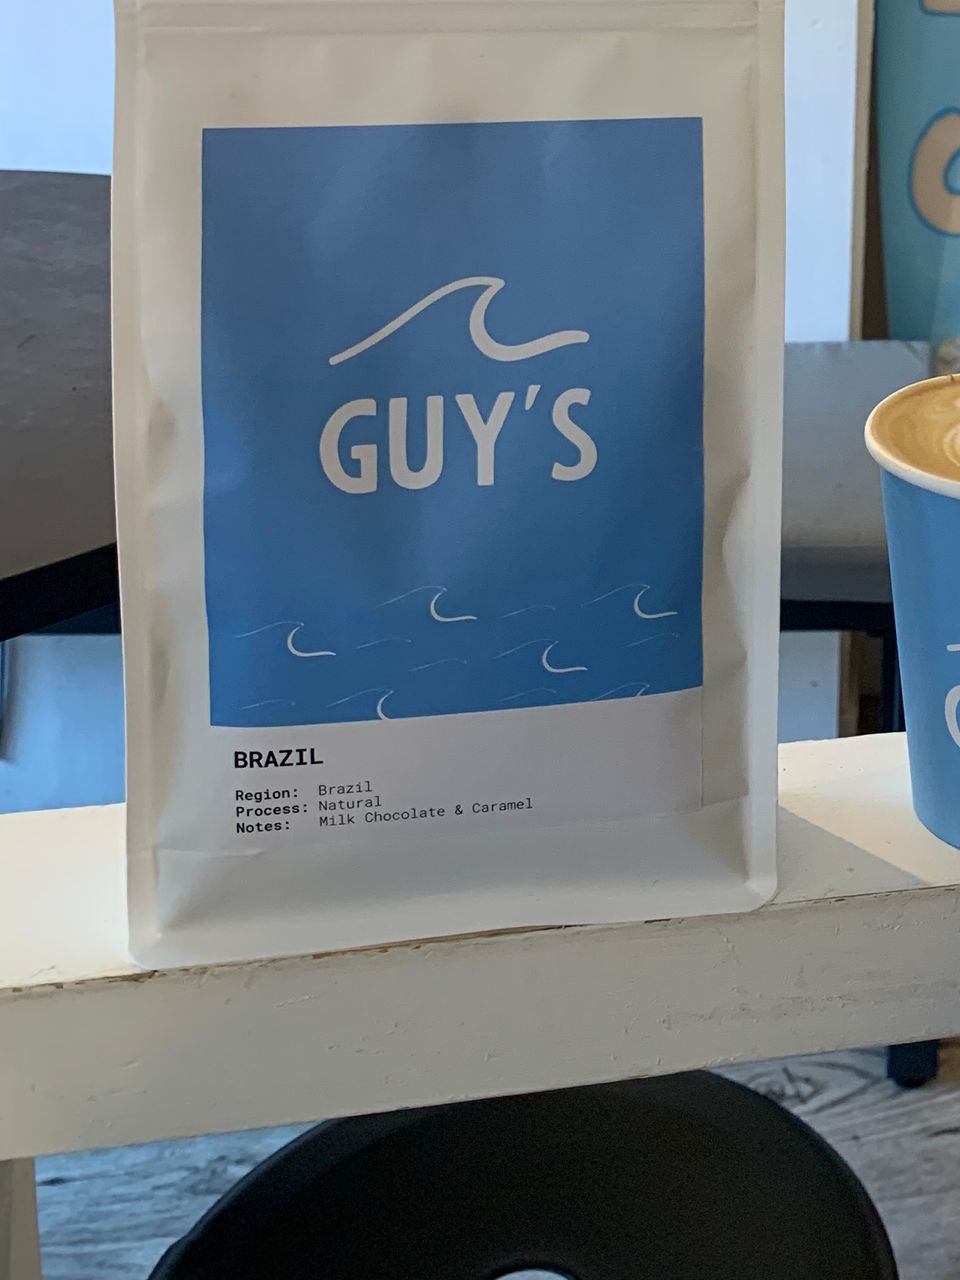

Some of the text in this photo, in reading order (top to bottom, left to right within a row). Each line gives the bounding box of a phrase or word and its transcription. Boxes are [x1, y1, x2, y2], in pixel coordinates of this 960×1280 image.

[319, 384, 598, 494] GUY'S
[234, 747, 324, 769] BRAZIL
[235, 780, 374, 803] Region: Brazil
[236, 795, 383, 818] Process: Natural
[236, 797, 534, 834] Notes: Milk Chocolate & Caramel
